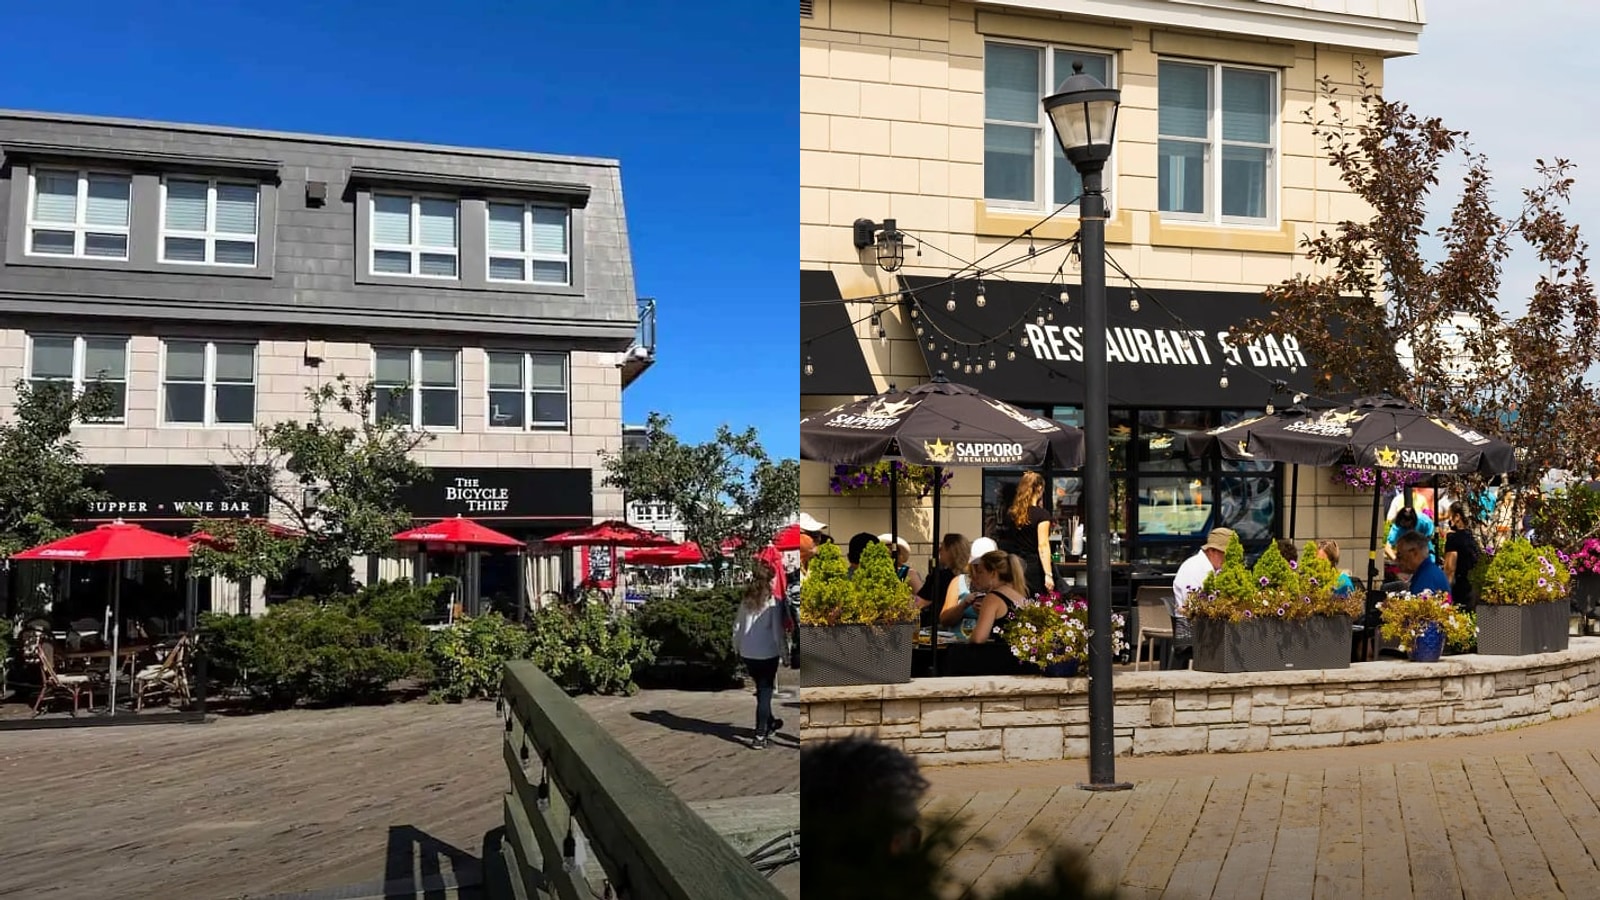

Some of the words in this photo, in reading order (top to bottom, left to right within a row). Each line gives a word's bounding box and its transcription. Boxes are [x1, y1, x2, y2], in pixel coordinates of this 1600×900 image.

[1025, 323, 1213, 365] RESAURANT
[1246, 333, 1308, 367] BAR
[956, 442, 1023, 457] SAPPORO
[1401, 450, 1459, 465] SAPPORO
[445, 487, 509, 500] BICYCLE
[173, 501, 214, 513] WNE
[220, 501, 250, 512] BAR
[465, 500, 509, 512] THIEF
